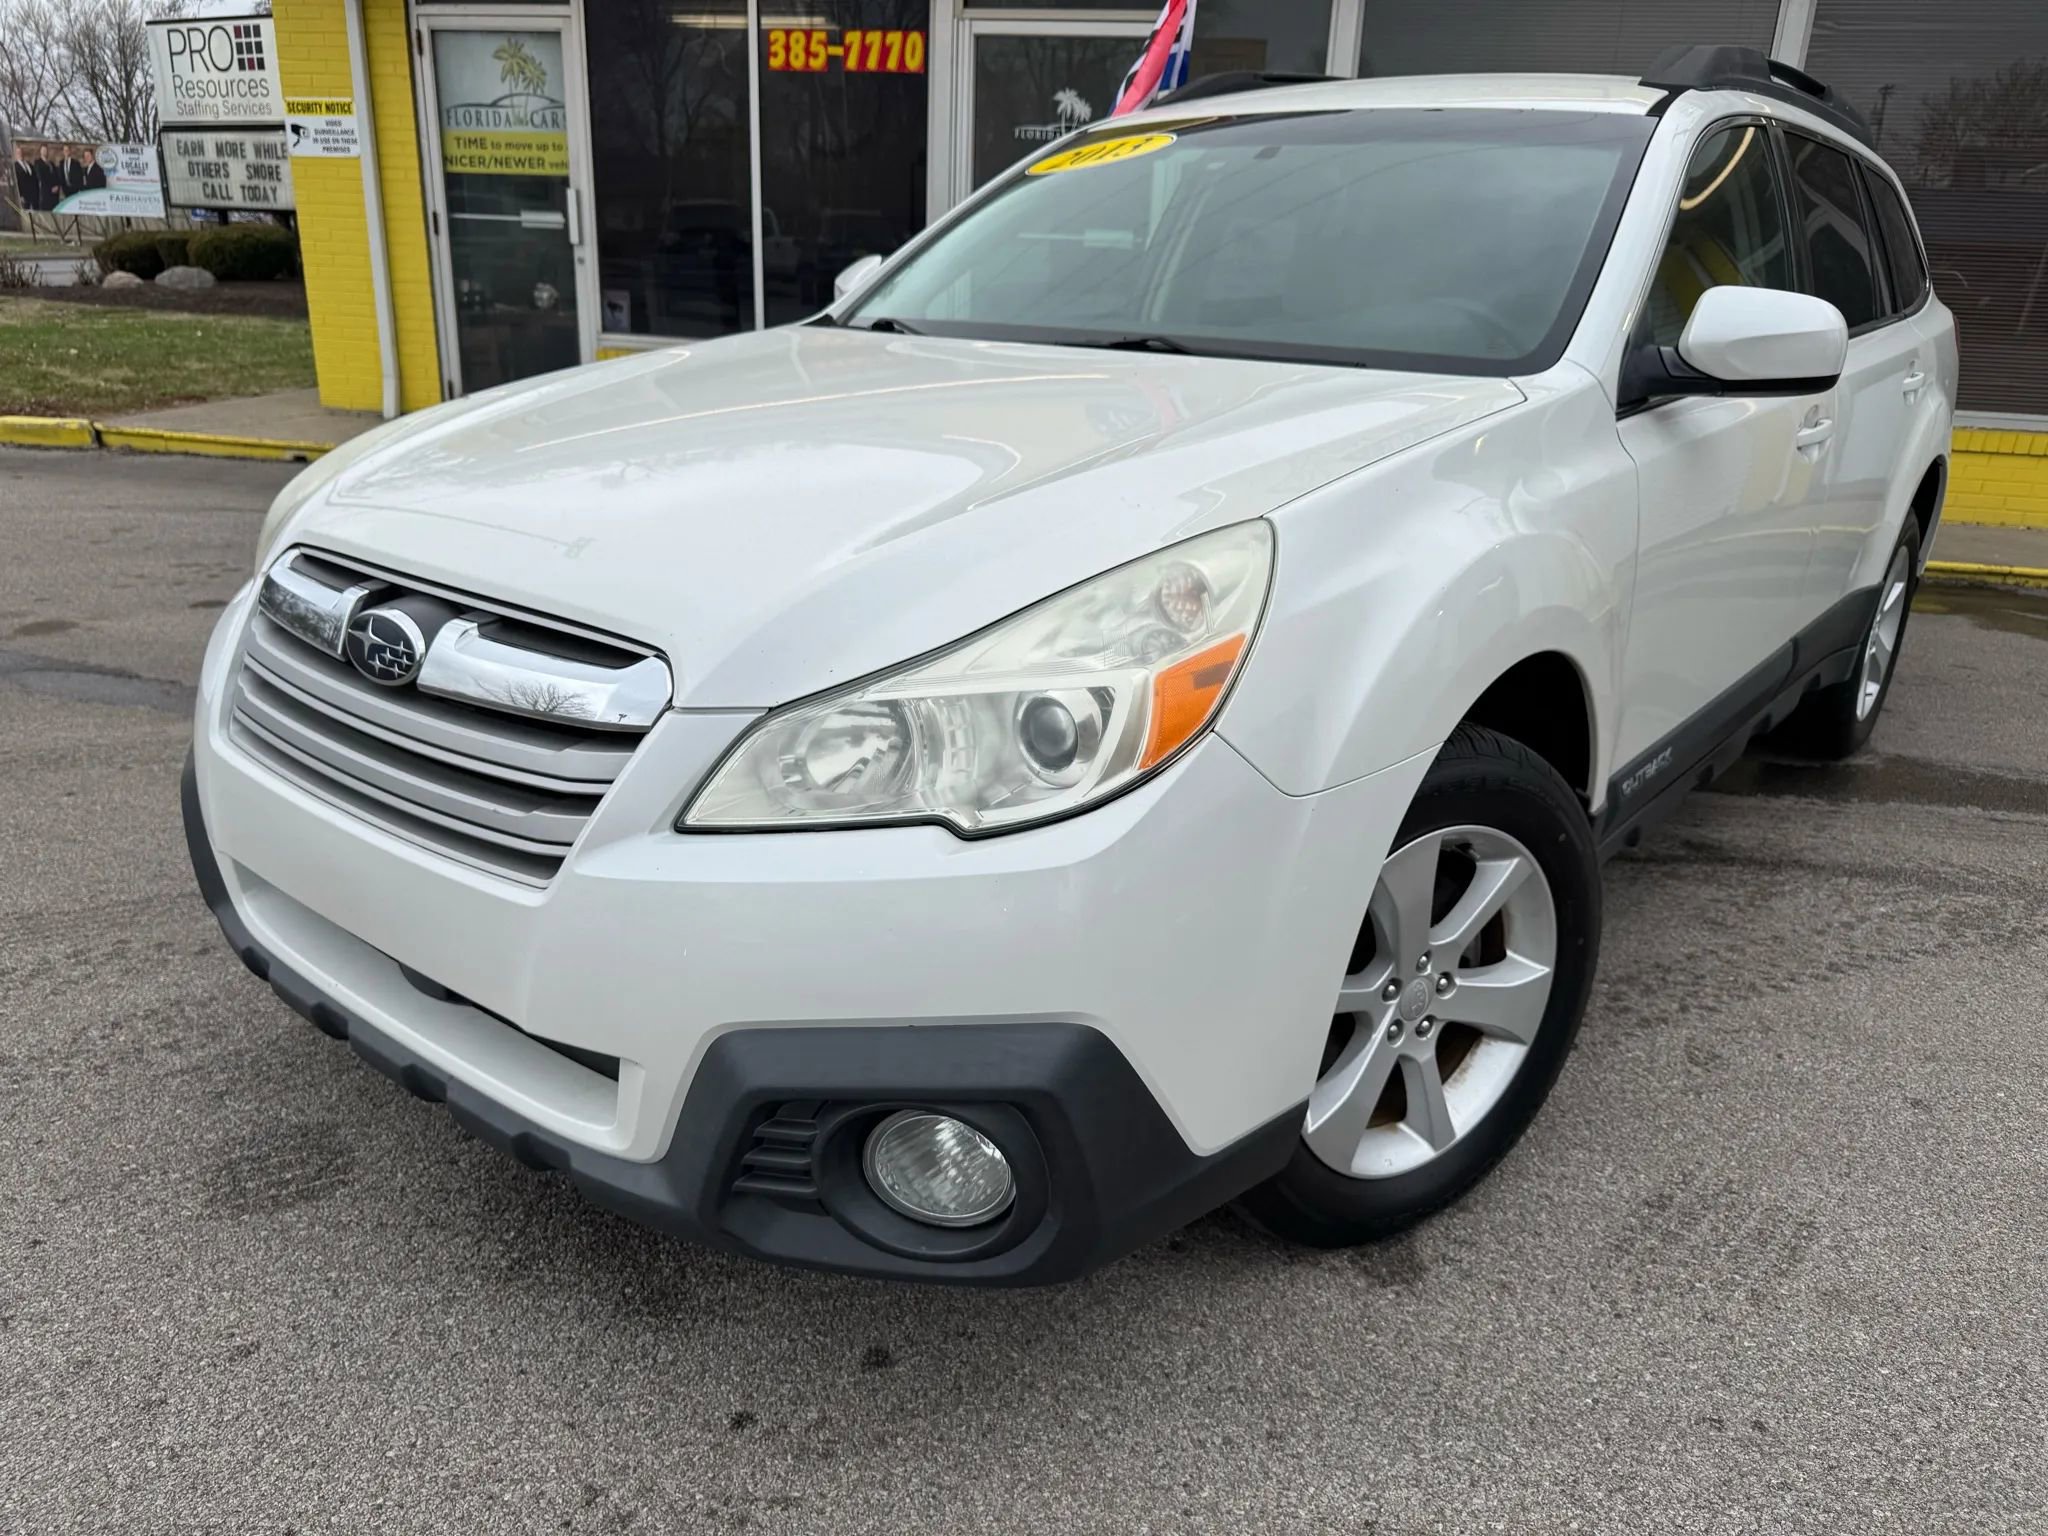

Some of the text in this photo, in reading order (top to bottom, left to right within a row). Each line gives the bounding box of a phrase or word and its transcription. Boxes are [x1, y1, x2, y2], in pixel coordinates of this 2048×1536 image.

[167, 25, 233, 72] PRO
[769, 30, 924, 71] 385-7770
[172, 74, 270, 98] Resources
[176, 100, 272, 119] Staffing Services
[287, 102, 352, 114] SECURITY NOTICE
[446, 109, 512, 128] FLORIDA
[177, 140, 288, 159] EARN MORE WHILE
[454, 136, 488, 150] TIME
[491, 141, 501, 150] to
[505, 141, 533, 151] move
[536, 143, 549, 153] up
[552, 142, 563, 151] to
[188, 160, 282, 182] OTHERS SNORE
[444, 154, 545, 170] NICER/NEWER
[202, 181, 278, 204] CALL TODAY
